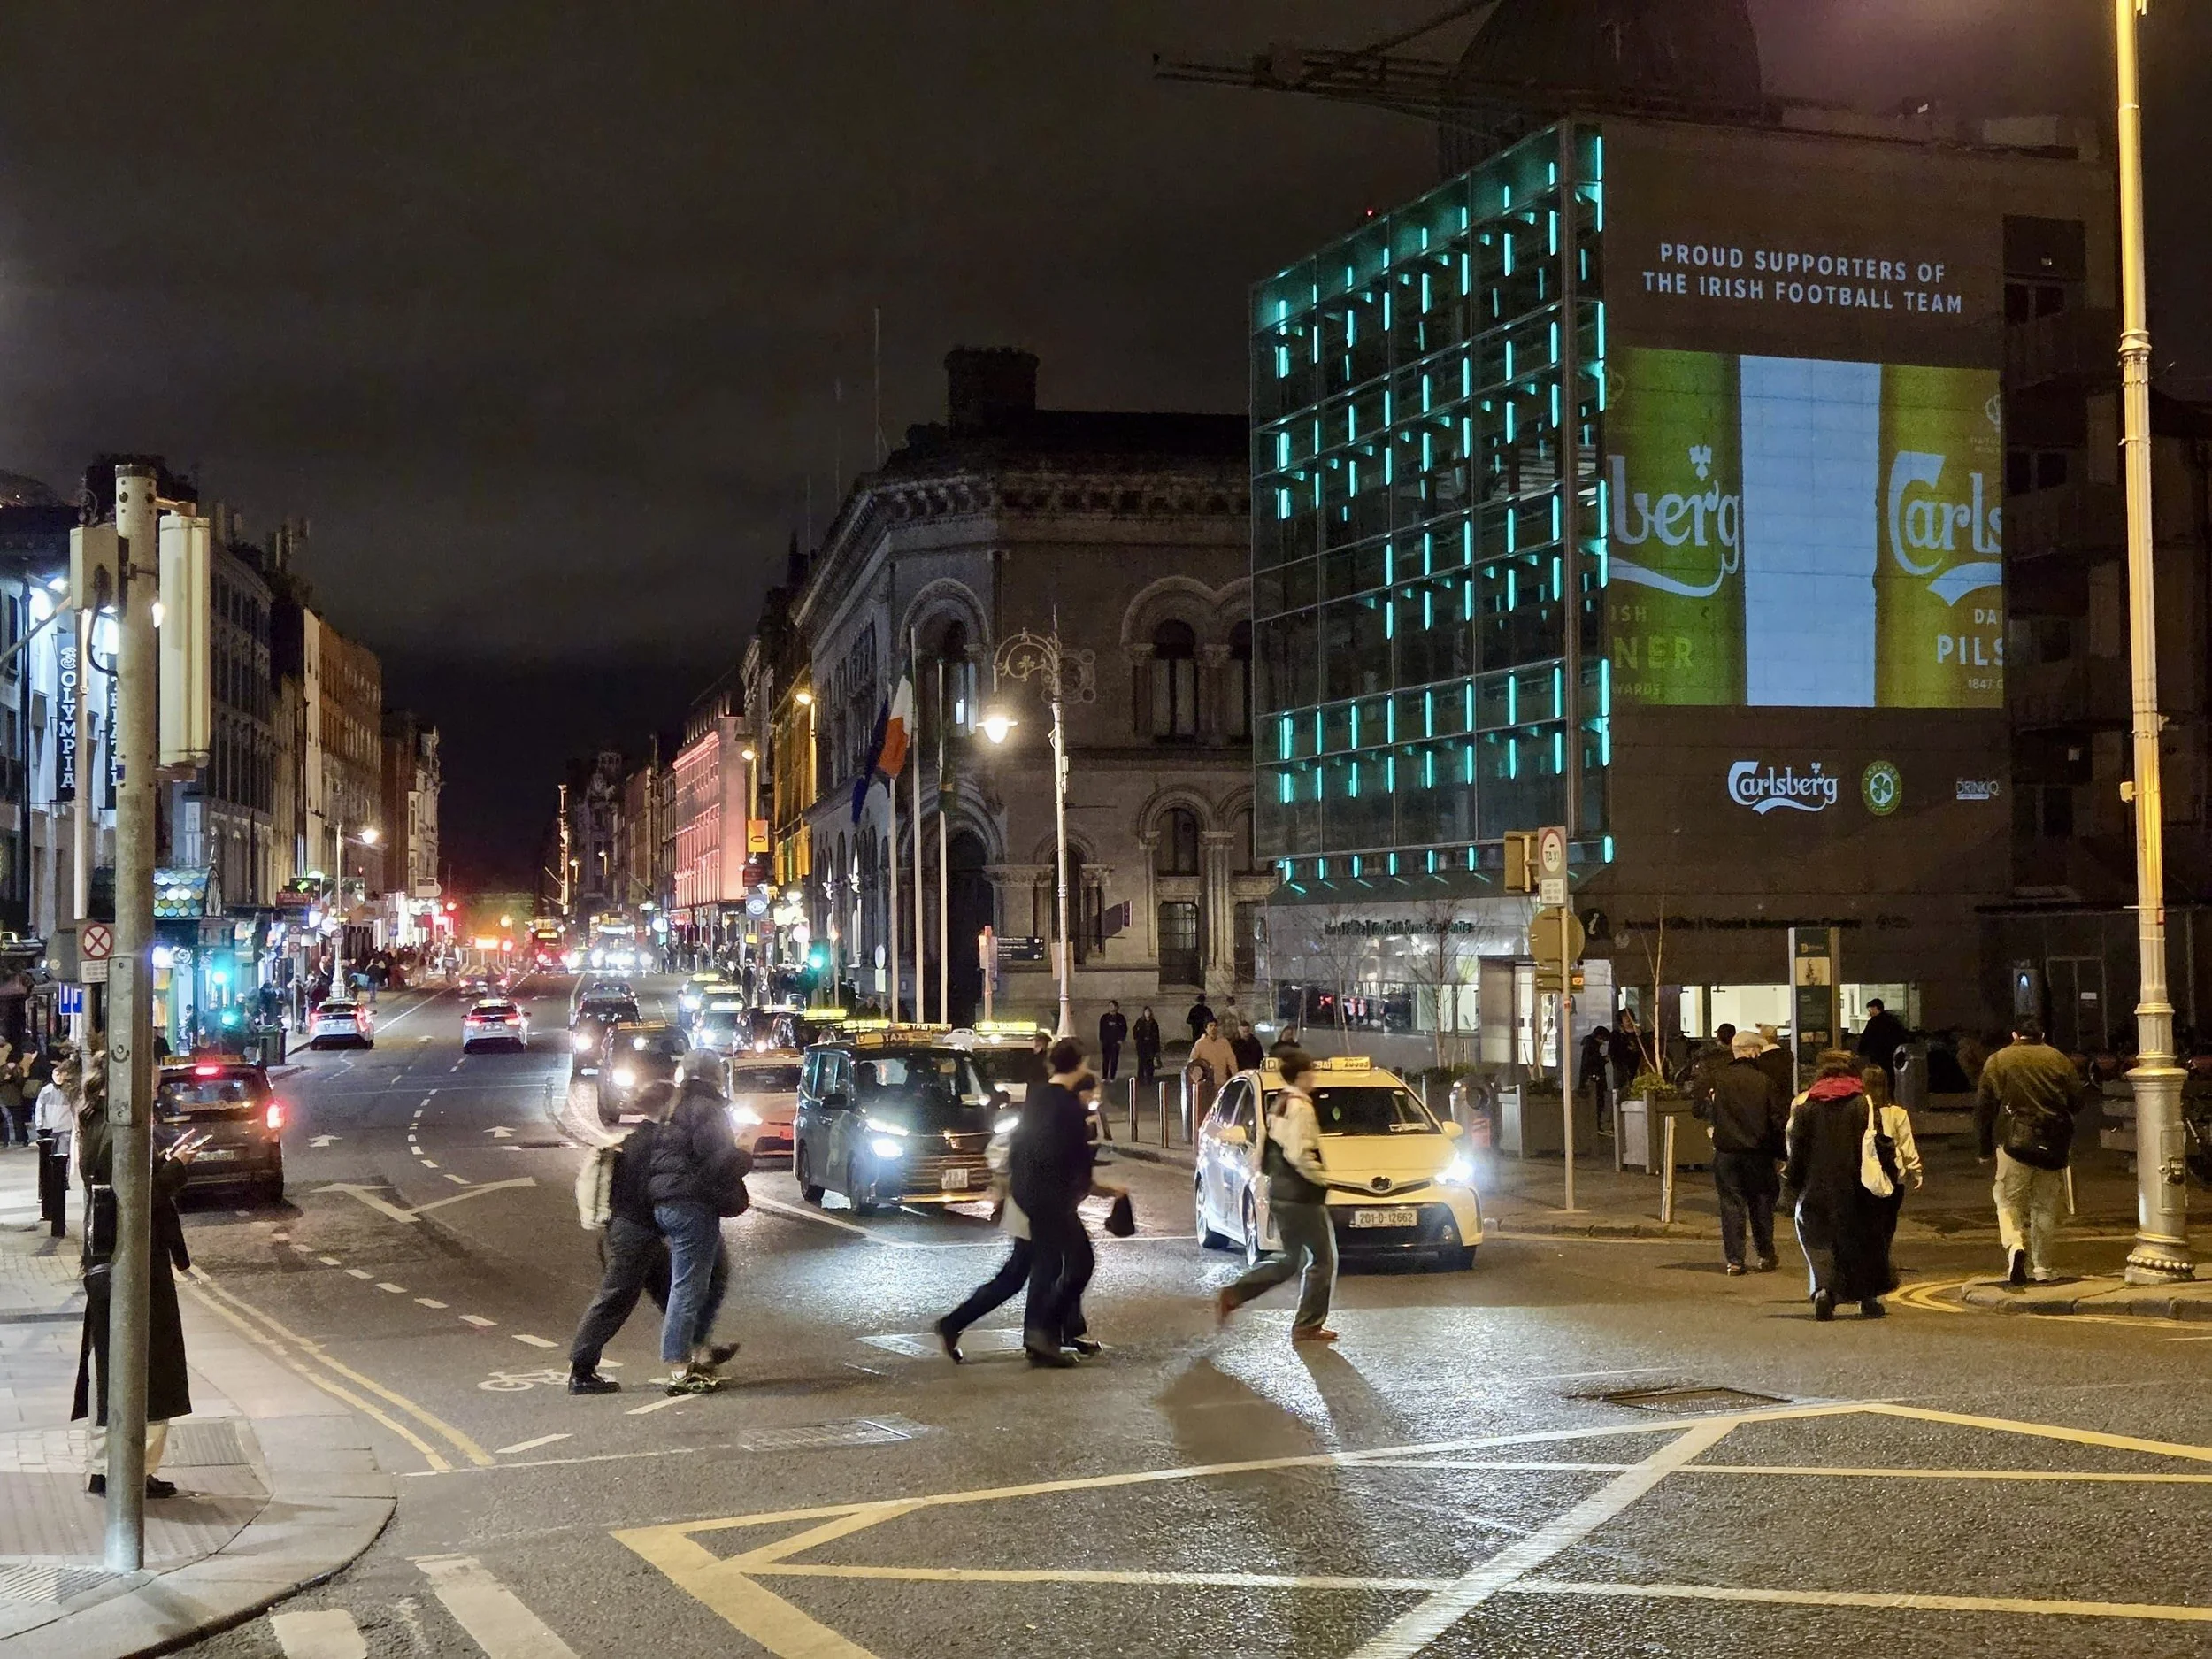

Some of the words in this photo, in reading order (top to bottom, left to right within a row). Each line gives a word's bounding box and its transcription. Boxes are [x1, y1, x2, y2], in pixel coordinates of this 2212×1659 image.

[1660, 242, 1743, 269] PROUD
[1755, 250, 1907, 281] SUPPORTERS
[1917, 263, 1945, 283] OF
[1642, 271, 1687, 295] THE
[1699, 275, 1763, 300] IRISH
[1775, 281, 1893, 310] FOOTBALL
[1903, 291, 1962, 314] TEAM
[1974, 608, 2002, 625] DA
[1613, 635, 1694, 669] NER
[1937, 634, 2003, 666] PILS
[1728, 761, 1838, 805] Carlsberg
[1544, 850, 1560, 862] TAXI
[883, 1033, 909, 1042] TAXI
